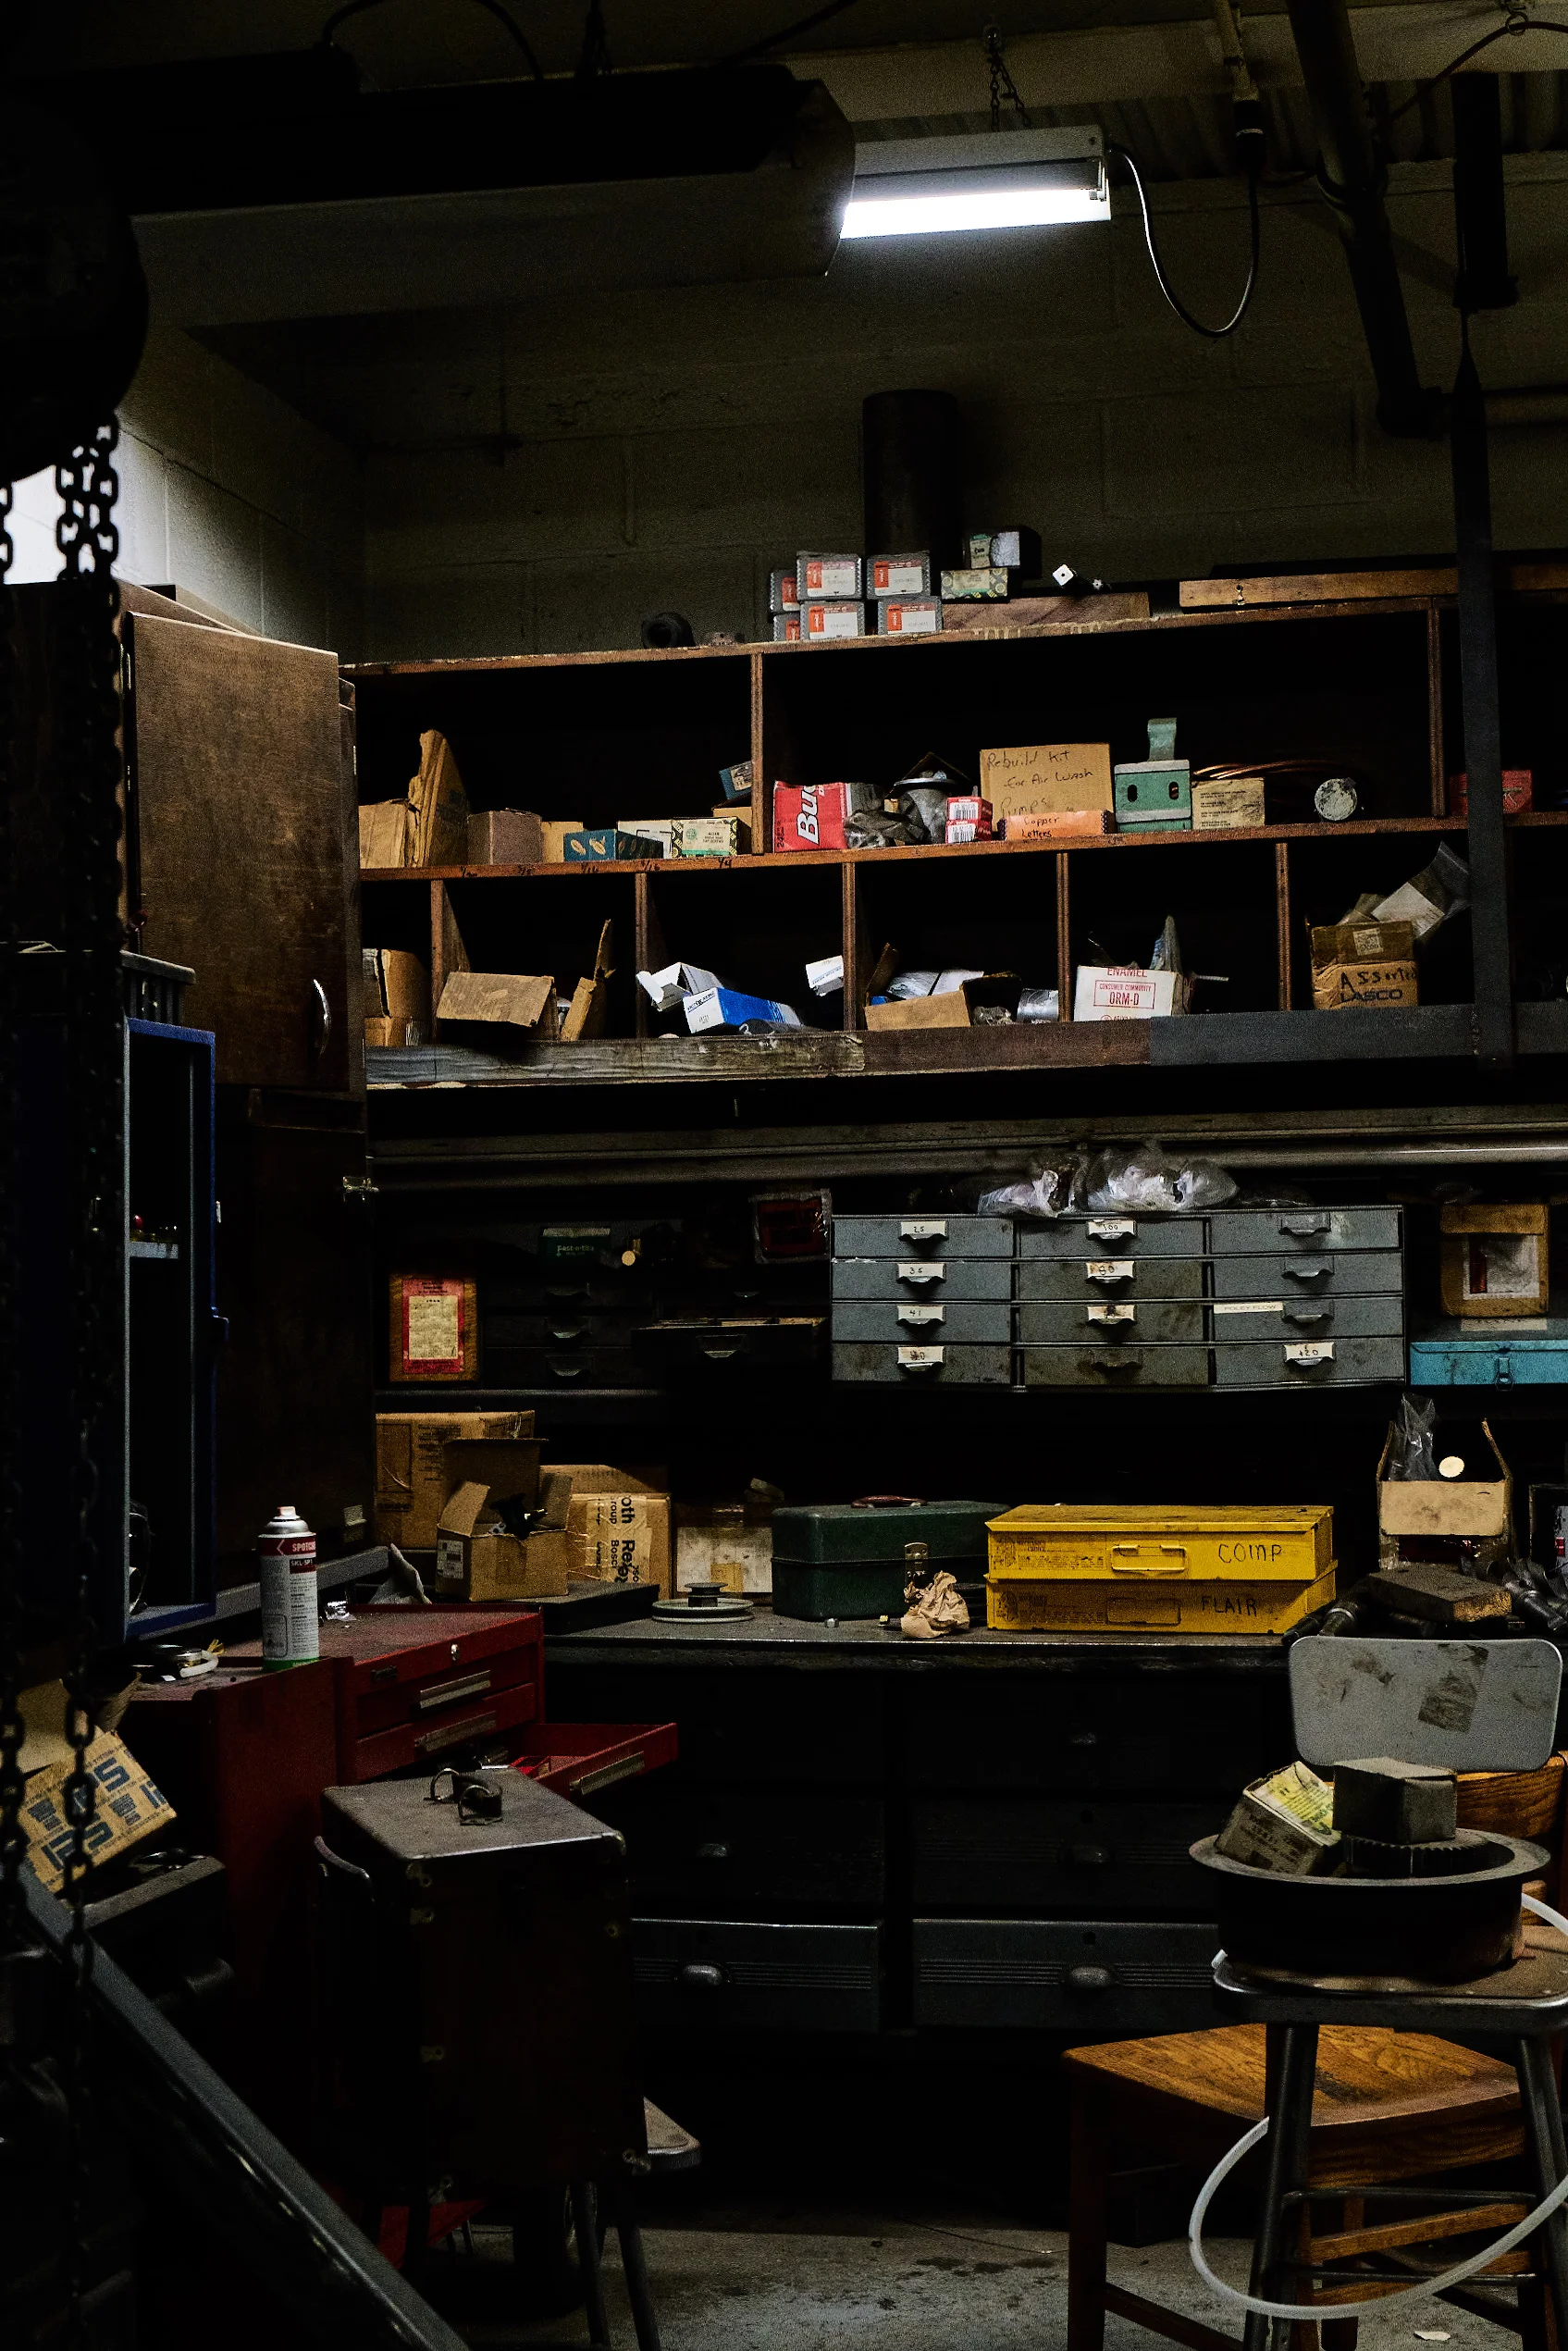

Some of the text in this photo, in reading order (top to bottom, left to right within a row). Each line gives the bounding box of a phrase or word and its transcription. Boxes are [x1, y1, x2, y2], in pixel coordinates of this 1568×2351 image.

[986, 750, 1038, 772] Rebuild
[1031, 773, 1048, 785] Air
[1106, 968, 1148, 978] ENAMEL
[1109, 991, 1140, 1006] ORM-D
[608, 1498, 618, 1525] roup
[1201, 1595, 1257, 1617] FLAIR
